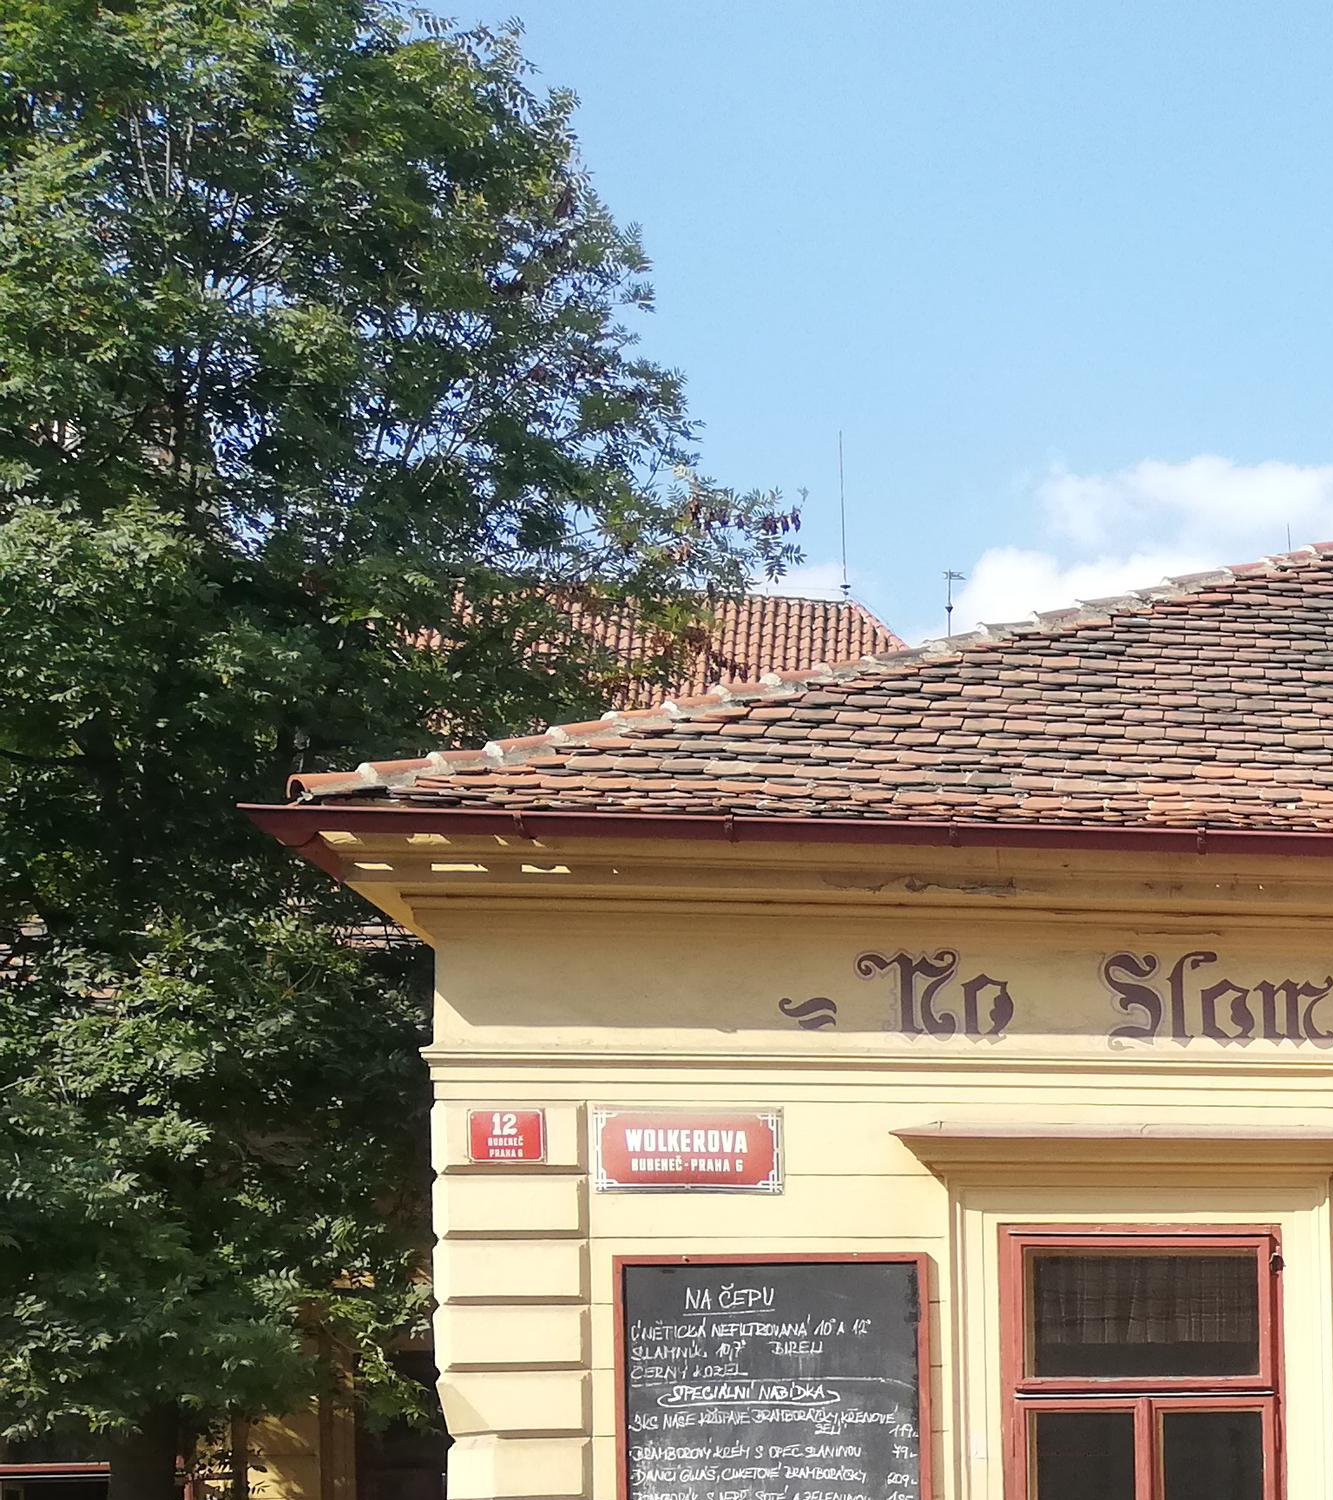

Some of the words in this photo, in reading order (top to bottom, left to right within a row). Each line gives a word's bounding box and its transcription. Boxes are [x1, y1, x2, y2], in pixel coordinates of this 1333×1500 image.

[492, 1112, 518, 1136] 12
[625, 1128, 748, 1153] WOLKEROVA
[489, 1148, 517, 1158] PRAHA
[517, 1148, 524, 1158] 6
[690, 1158, 731, 1172] PRAHA
[735, 1159, 743, 1172] 6
[685, 1287, 712, 1311] NA
[718, 1282, 775, 1309] ČEPU
[758, 1381, 826, 1401] NABÍDKA
